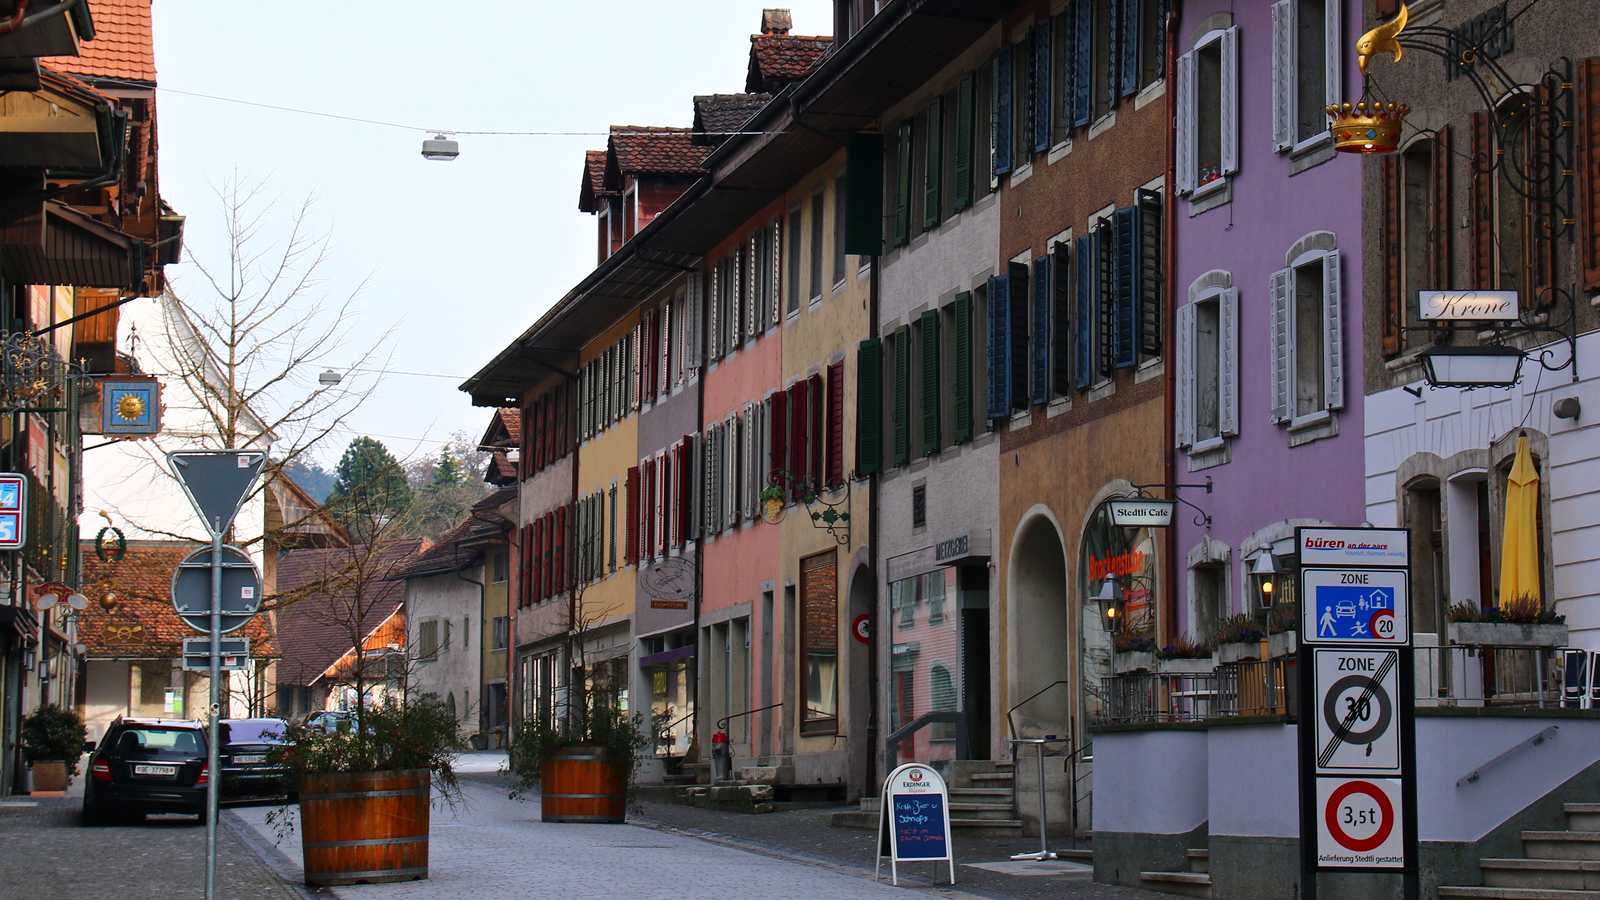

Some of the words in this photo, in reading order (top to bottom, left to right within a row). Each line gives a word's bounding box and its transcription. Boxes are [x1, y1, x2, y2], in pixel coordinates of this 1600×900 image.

[1443, 1, 1514, 81] HOTEL
[1425, 291, 1511, 319] Krone
[1117, 508, 1147, 517] Stedtli
[1149, 508, 1168, 517] Café
[936, 535, 968, 561] METZGEREI
[1305, 537, 1345, 548] büren
[1089, 544, 1143, 582] Brockenstube
[1341, 574, 1369, 584] ZONE
[1379, 620, 1394, 632] 20
[1338, 658, 1375, 671] ZONE
[1345, 697, 1371, 721] 30
[1319, 855, 1354, 864] Anlieferung
[1376, 856, 1403, 864] gestattet
